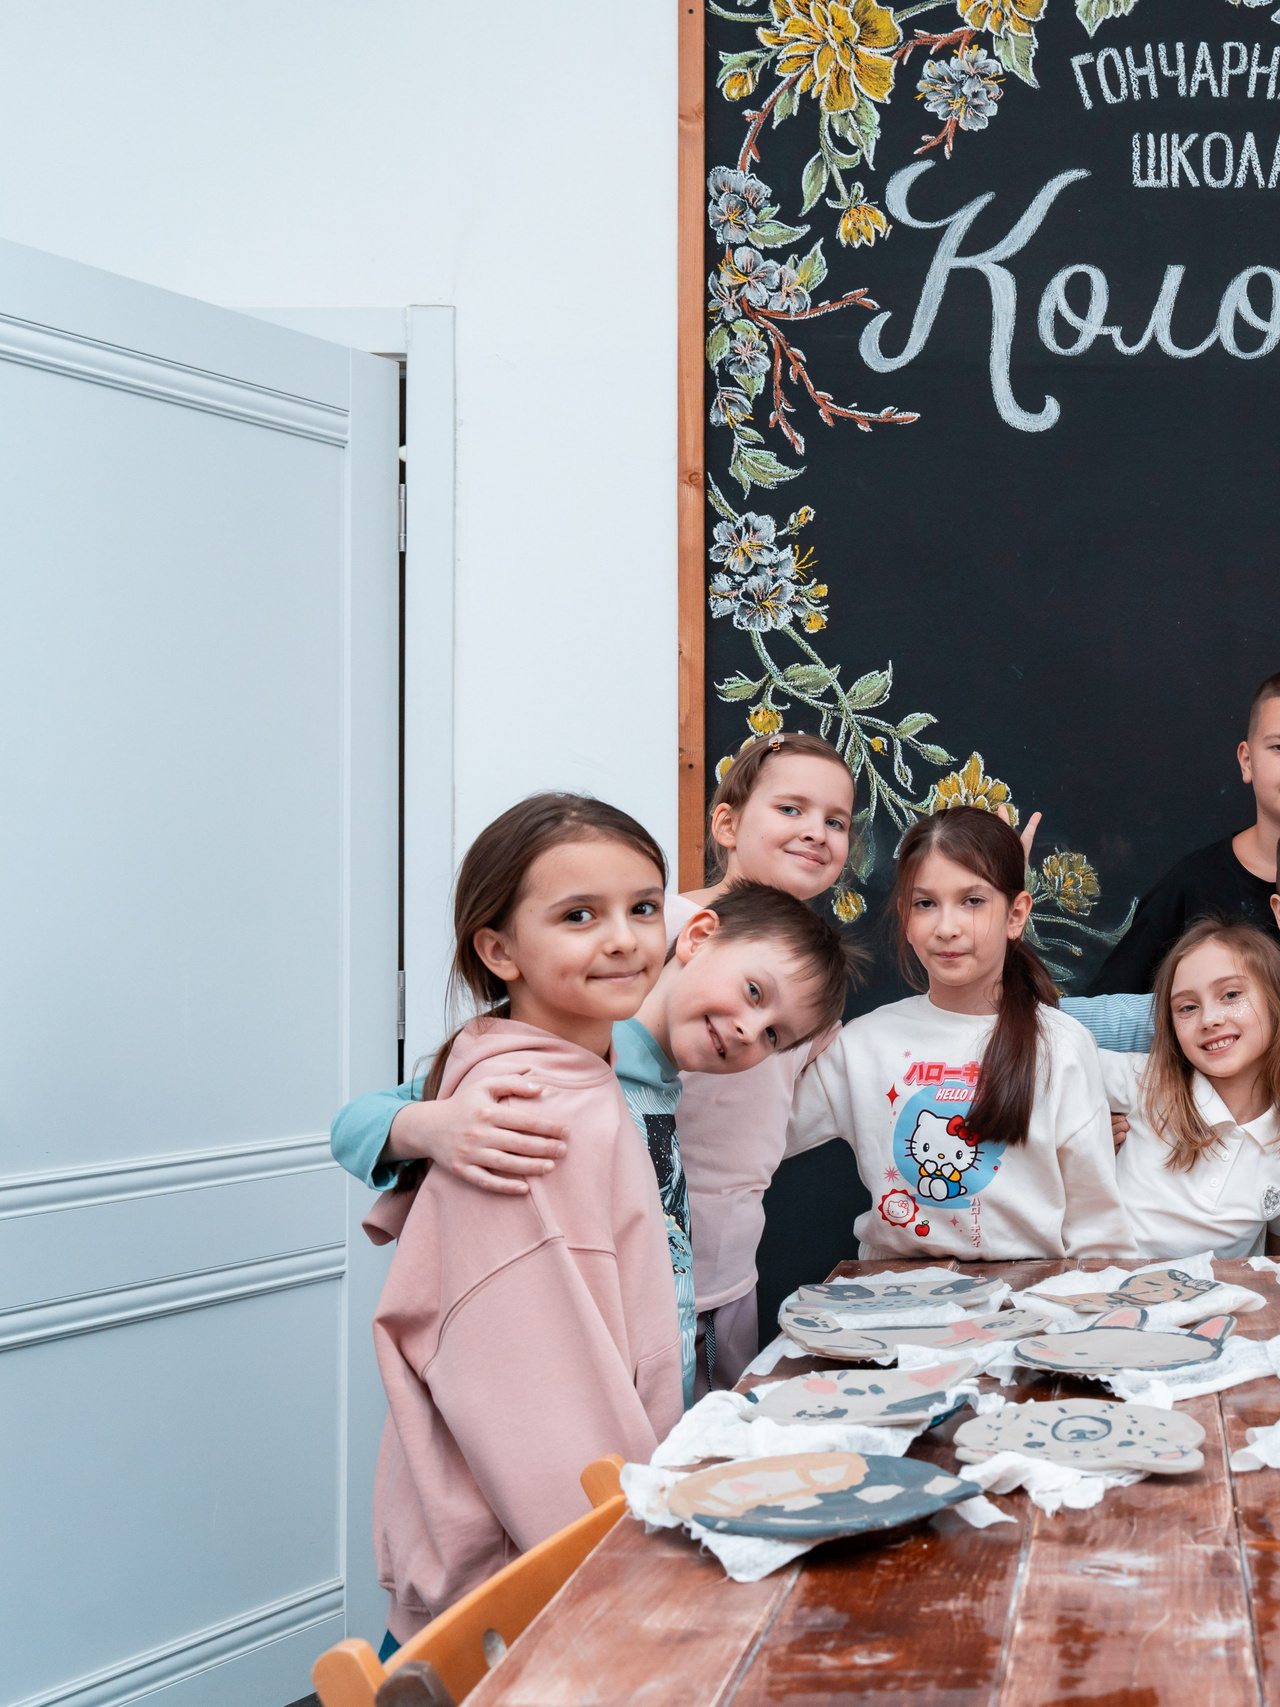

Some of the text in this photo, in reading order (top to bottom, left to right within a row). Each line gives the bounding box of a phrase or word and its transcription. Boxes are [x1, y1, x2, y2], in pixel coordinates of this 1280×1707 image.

[903, 1061, 982, 1087] ハローキ
[935, 1087, 968, 1103] HELLO
